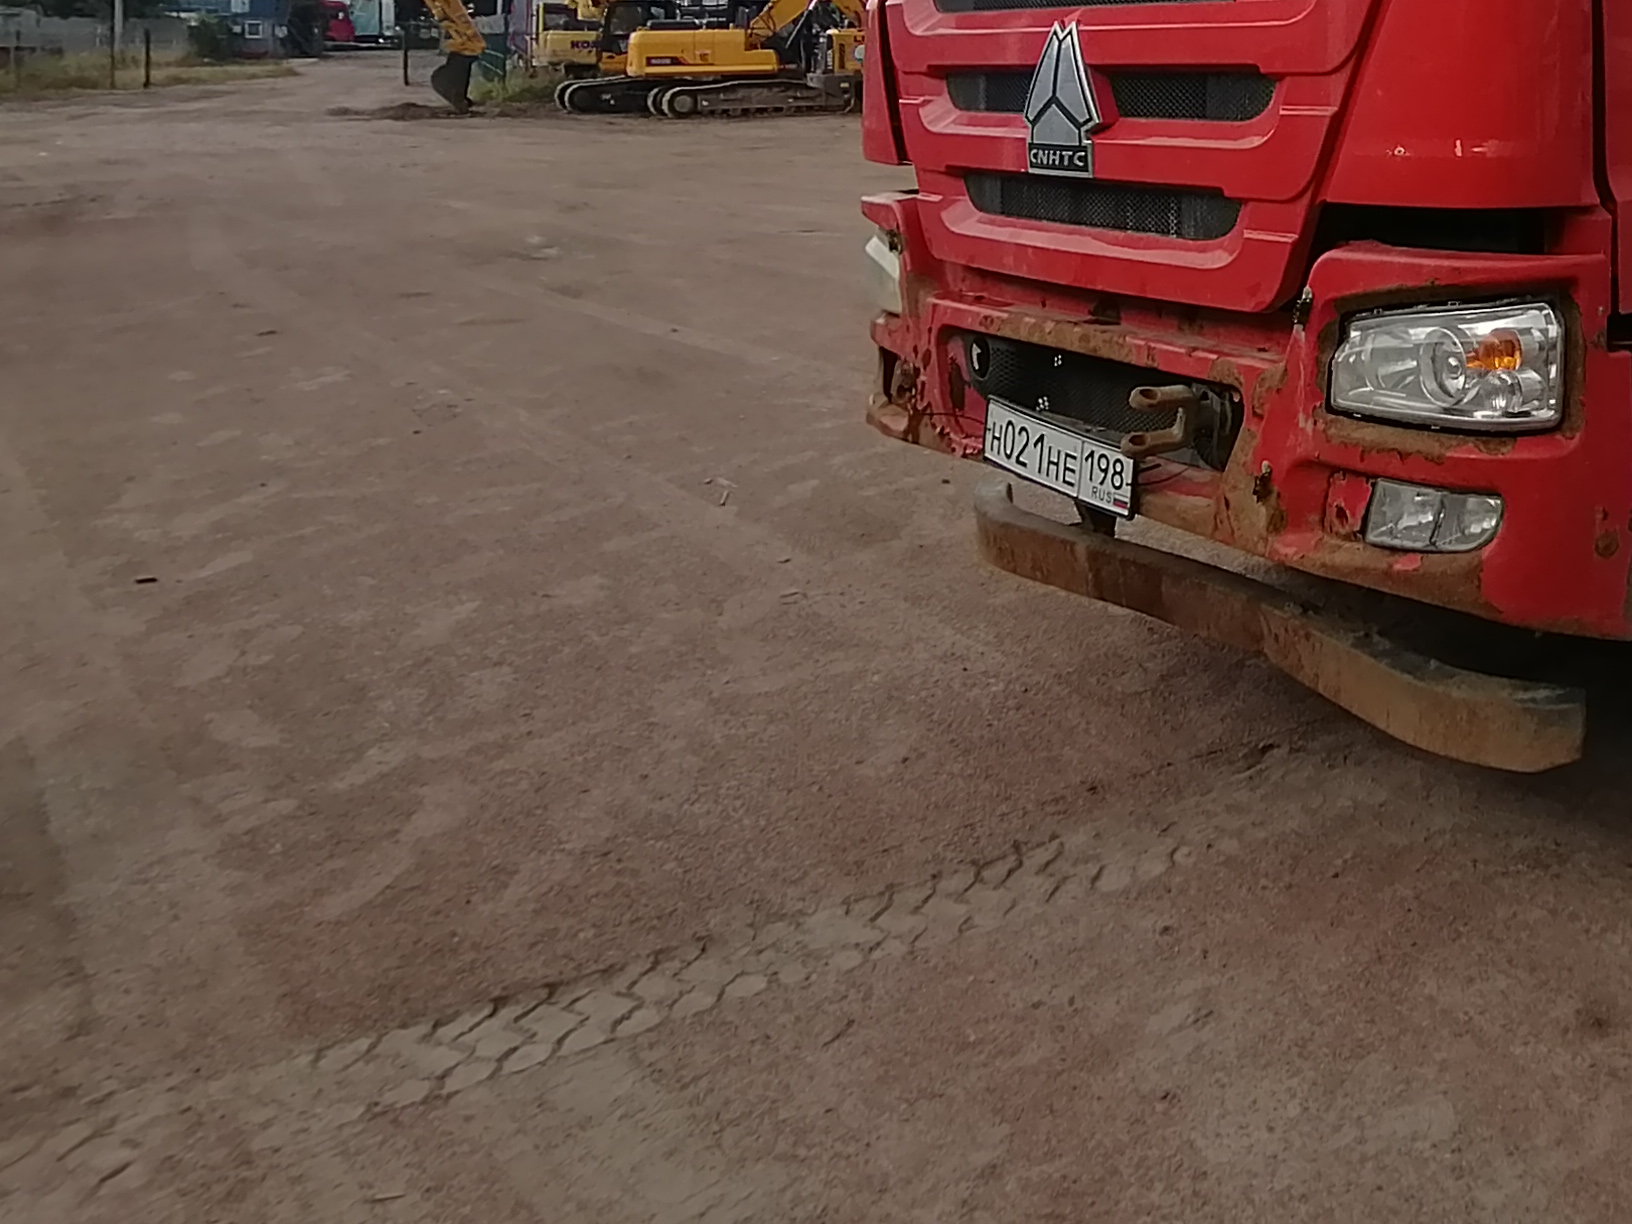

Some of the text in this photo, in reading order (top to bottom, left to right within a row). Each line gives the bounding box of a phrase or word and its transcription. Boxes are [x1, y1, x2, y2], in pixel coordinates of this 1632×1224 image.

[1030, 148, 1086, 166] CNHTC
[1084, 449, 1124, 490] 198
[1091, 486, 1113, 504] RUS
